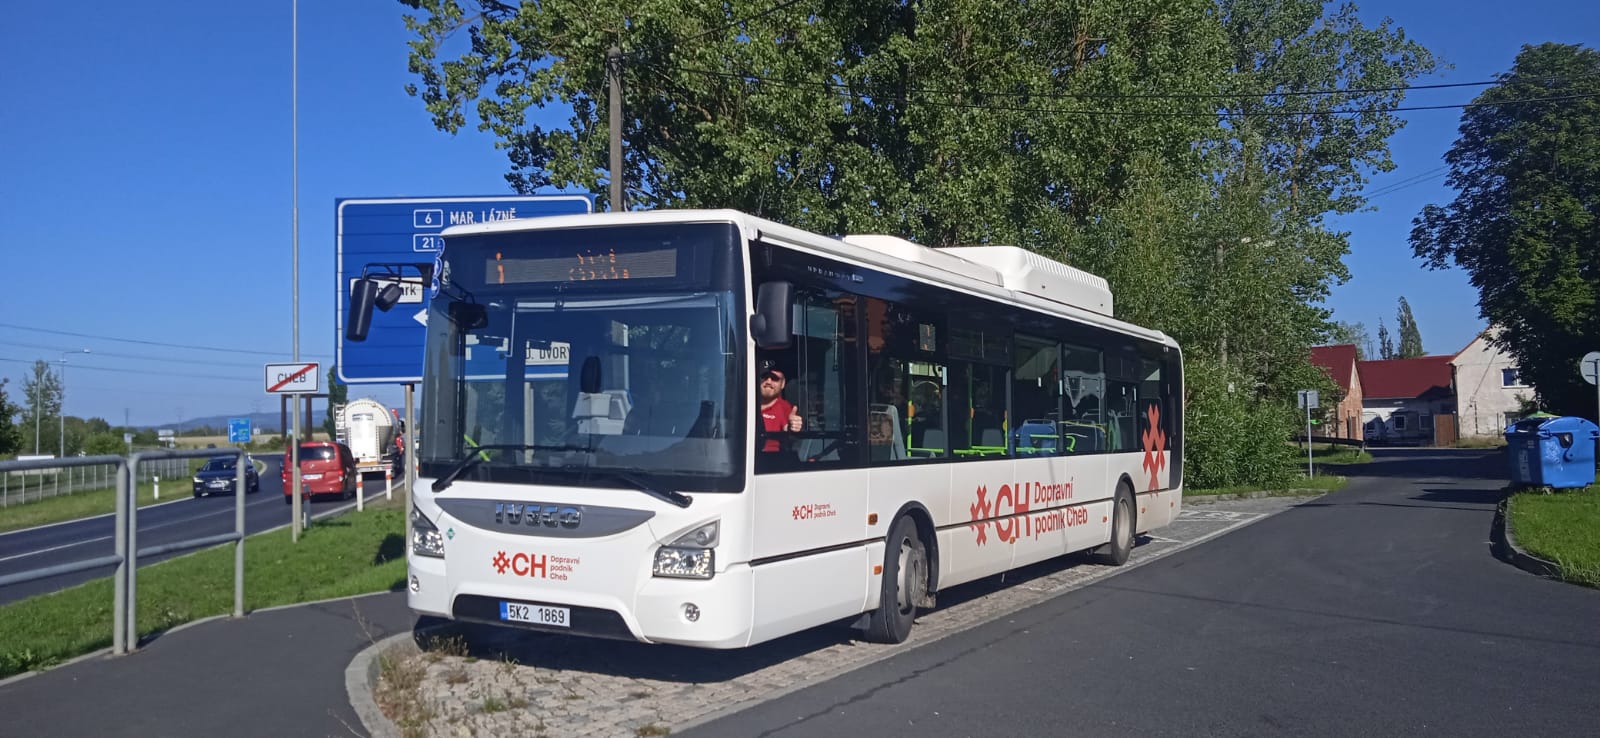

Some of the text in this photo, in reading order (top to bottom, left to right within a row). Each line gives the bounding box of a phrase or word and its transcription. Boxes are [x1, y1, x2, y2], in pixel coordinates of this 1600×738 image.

[425, 207, 516, 225] 6 MAR. LÁZNĚ
[422, 237, 434, 248] 21
[277, 373, 306, 383] CHEB
[1034, 476, 1073, 507] Dopravní
[495, 503, 581, 529] IVECO
[800, 504, 813, 519] CH
[994, 482, 1031, 542] CH
[1035, 505, 1088, 541] podnik Cheb
[512, 552, 547, 578] CH
[550, 555, 580, 565] Dopravní
[550, 564, 573, 572] podnik
[550, 572, 568, 580] Cheb
[509, 605, 565, 624] 5K2 1869
